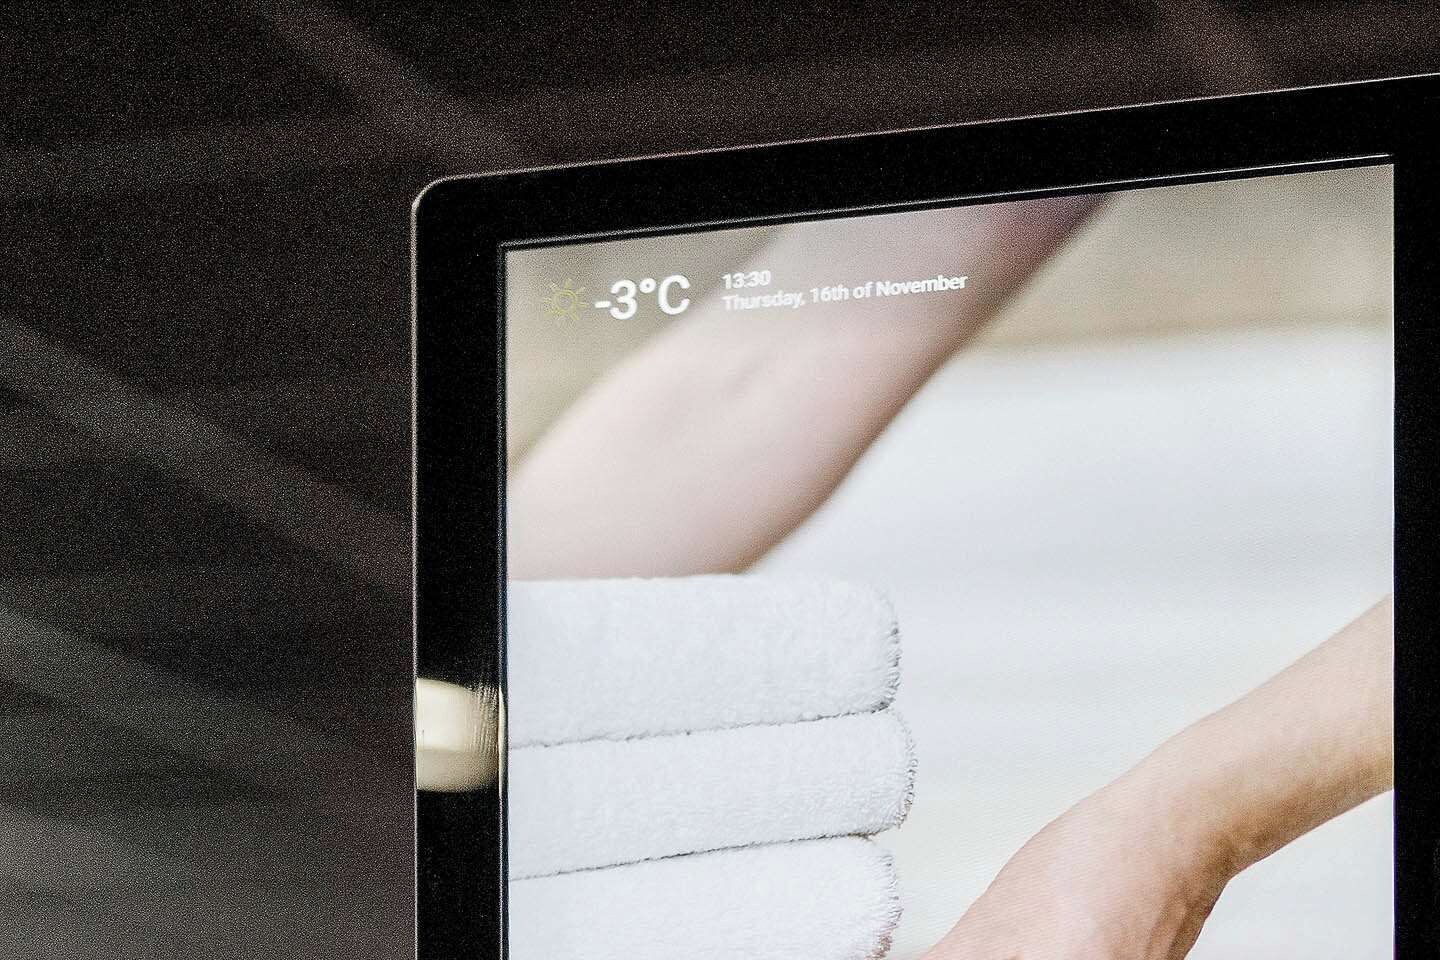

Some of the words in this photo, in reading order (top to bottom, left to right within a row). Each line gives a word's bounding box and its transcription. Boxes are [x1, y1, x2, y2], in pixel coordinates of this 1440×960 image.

[594, 274, 691, 321] -3°C
[722, 270, 772, 290] 13:30
[722, 288, 805, 311] Thursday,
[810, 285, 849, 303] 16th
[852, 282, 875, 299] of
[876, 273, 969, 297] November
